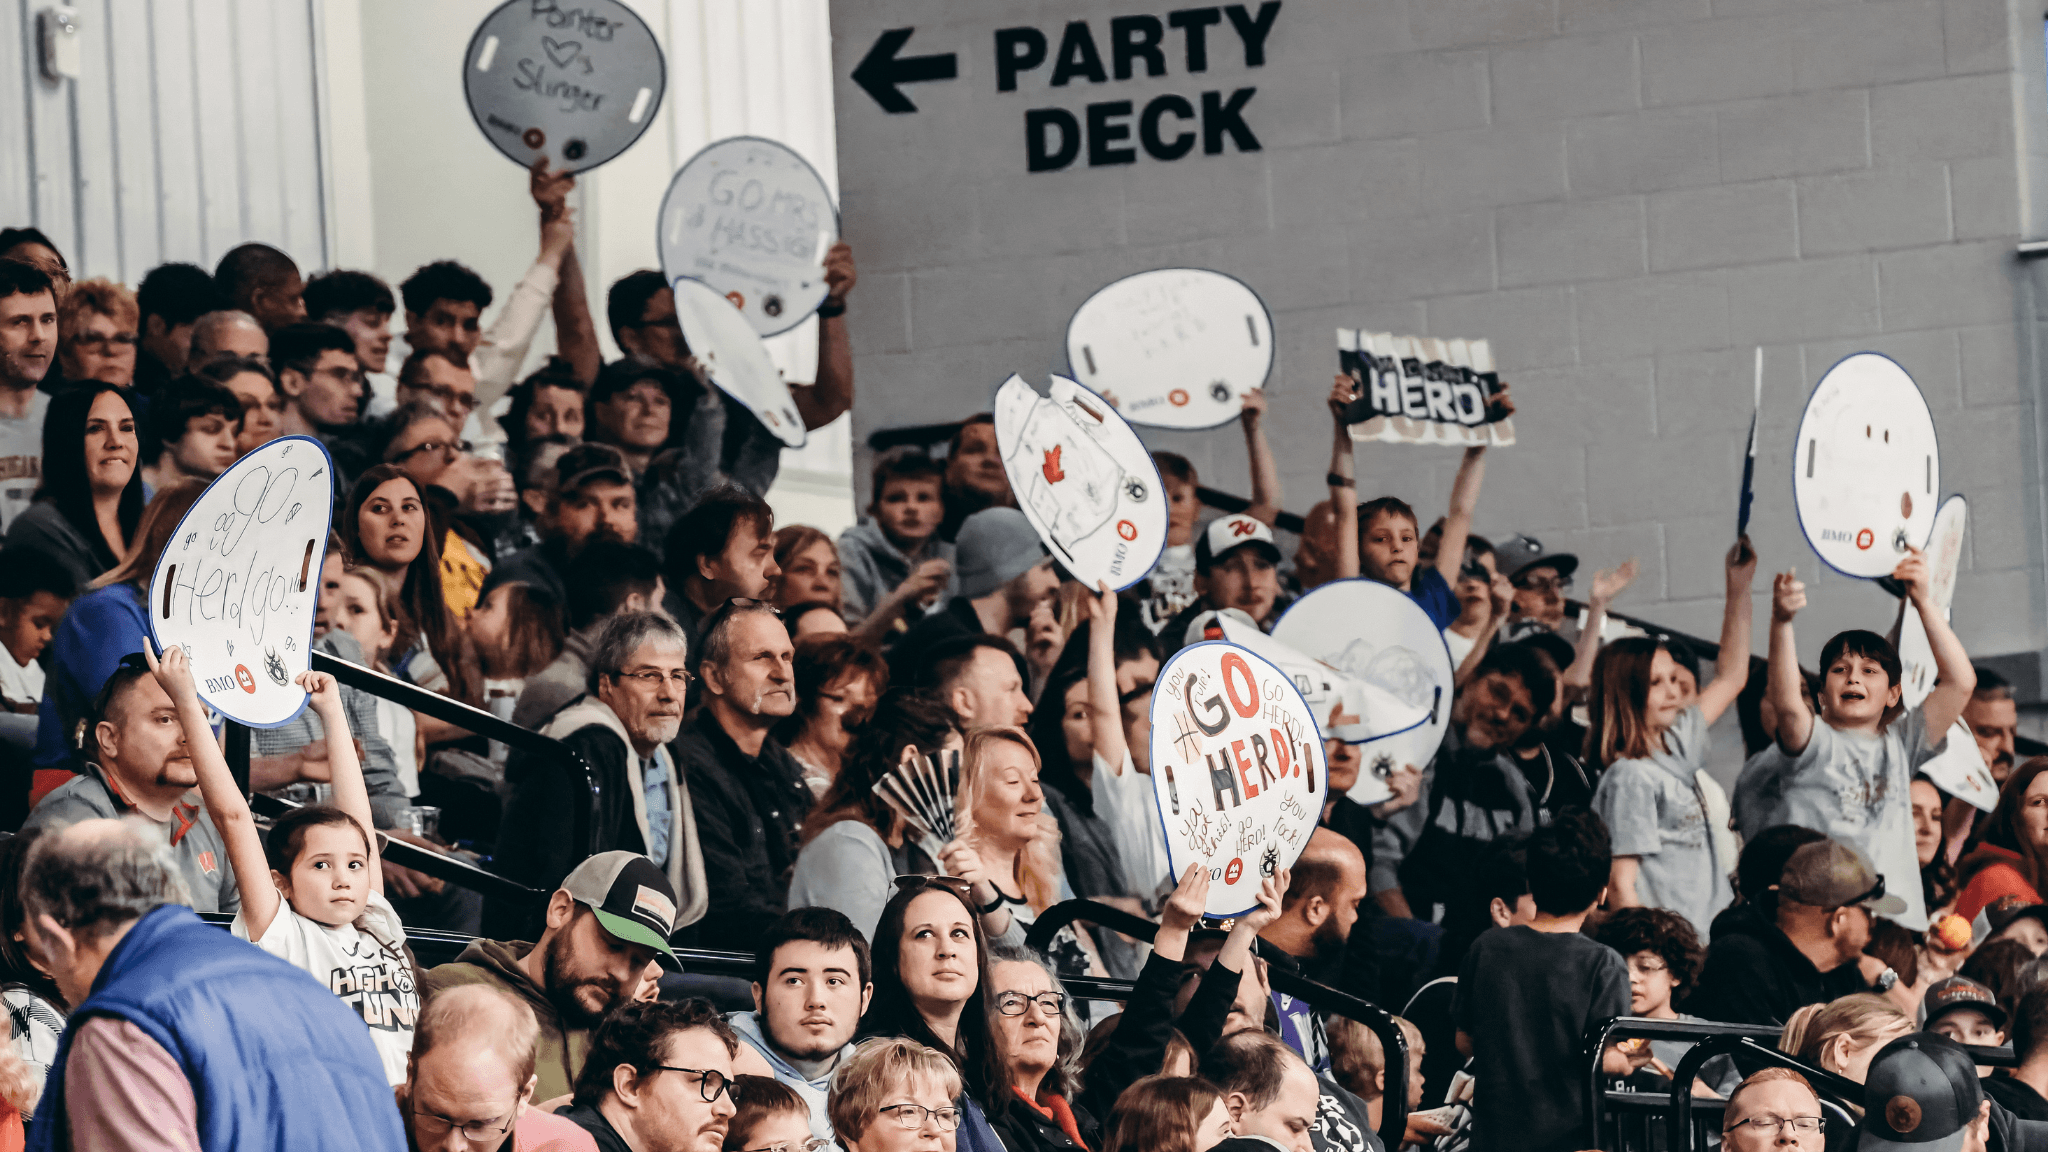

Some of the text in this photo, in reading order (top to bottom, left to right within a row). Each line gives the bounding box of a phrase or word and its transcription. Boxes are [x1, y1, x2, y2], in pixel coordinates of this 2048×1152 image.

[994, 0, 1282, 93] PARTY
[512, 57, 605, 113] Slinger
[1025, 87, 1263, 173] DECK
[172, 547, 258, 629] Herd
[205, 674, 236, 694] BMO
[1166, 667, 1185, 700] you
[1184, 652, 1260, 738] GO
[1263, 679, 1284, 702] GO
[1205, 722, 1300, 812] HERD!
[1279, 789, 1307, 821] you
